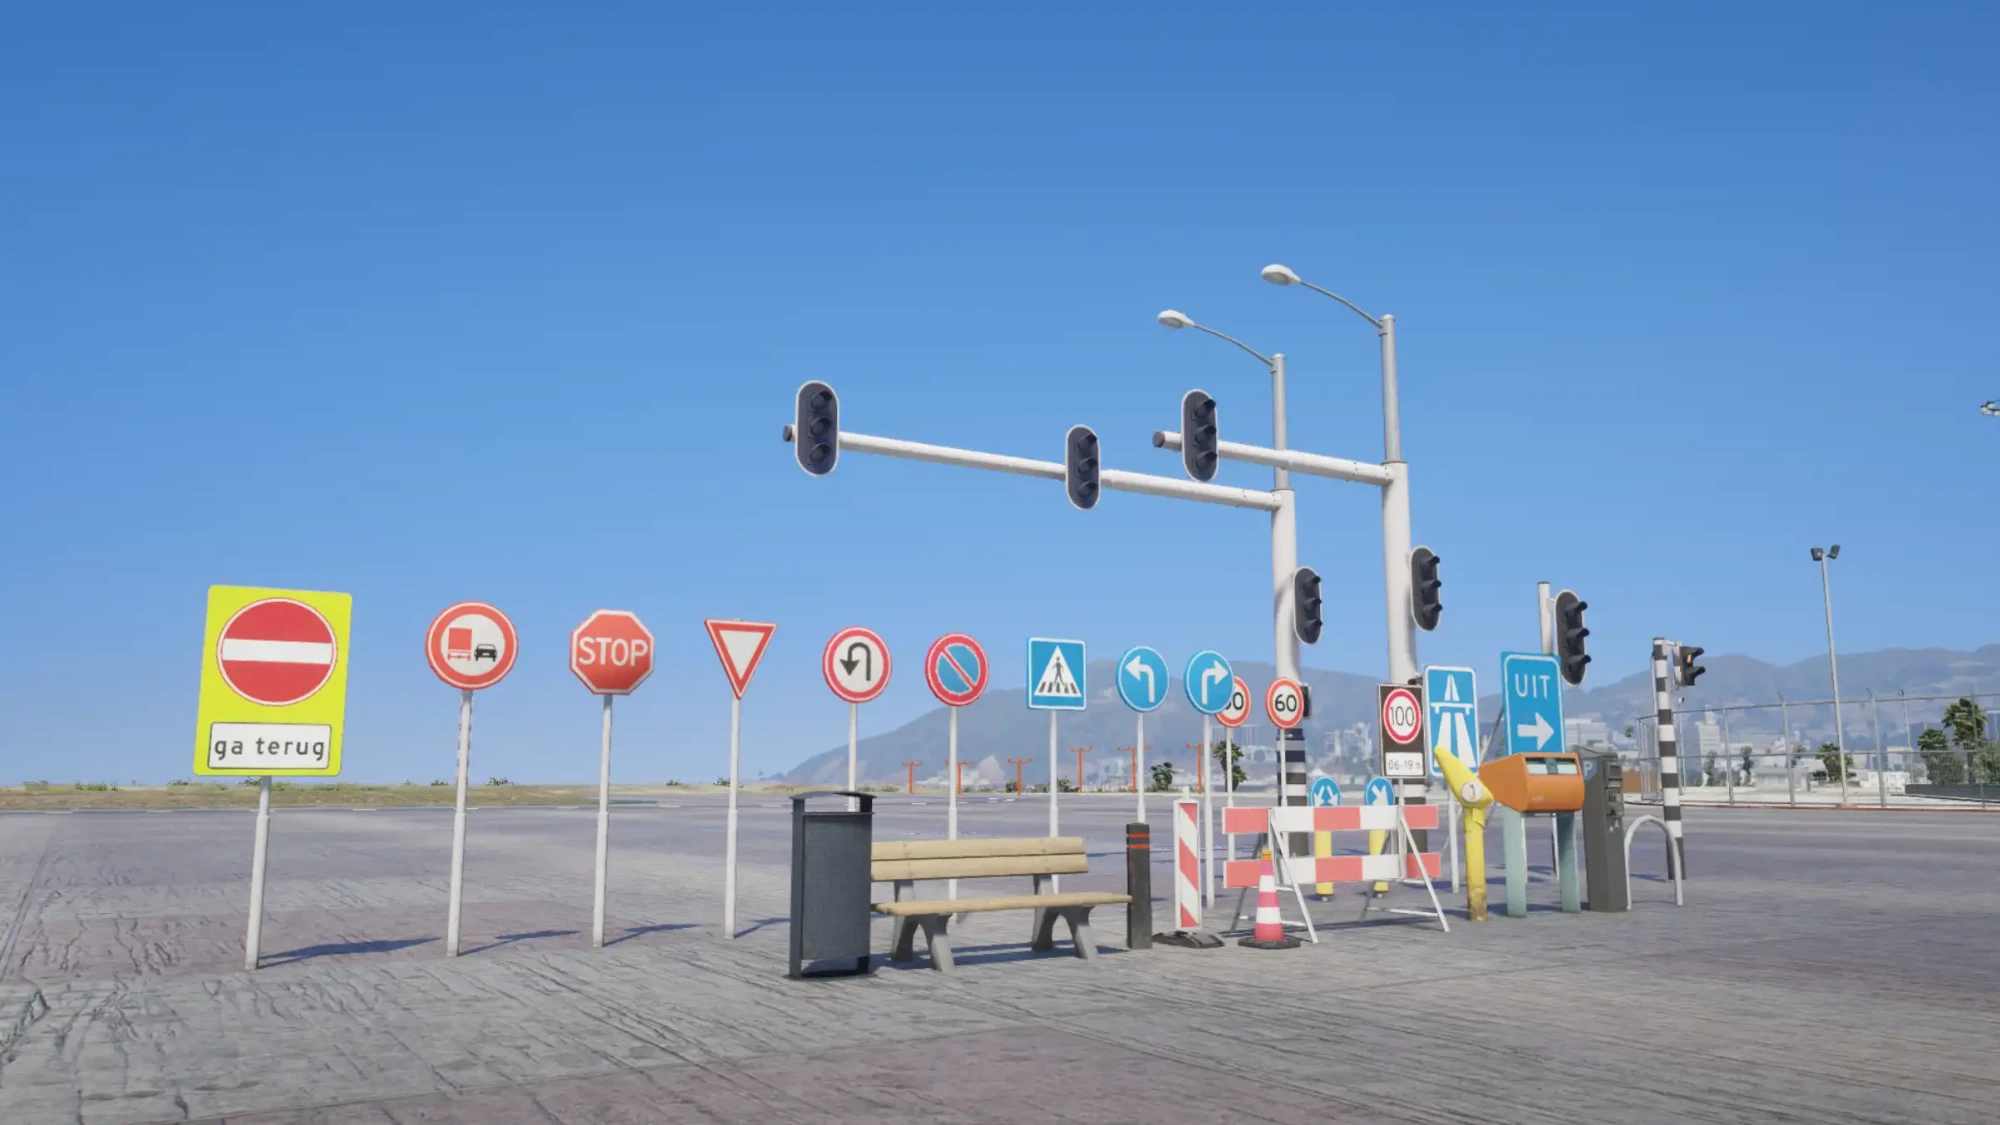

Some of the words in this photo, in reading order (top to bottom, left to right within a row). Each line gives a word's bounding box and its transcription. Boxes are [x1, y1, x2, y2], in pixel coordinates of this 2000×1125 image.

[578, 636, 649, 666] STOP
[1514, 672, 1551, 699] UIT
[1274, 694, 1297, 712] 60
[1390, 705, 1415, 727] 100
[214, 740, 243, 760] ga
[255, 737, 325, 761] terug
